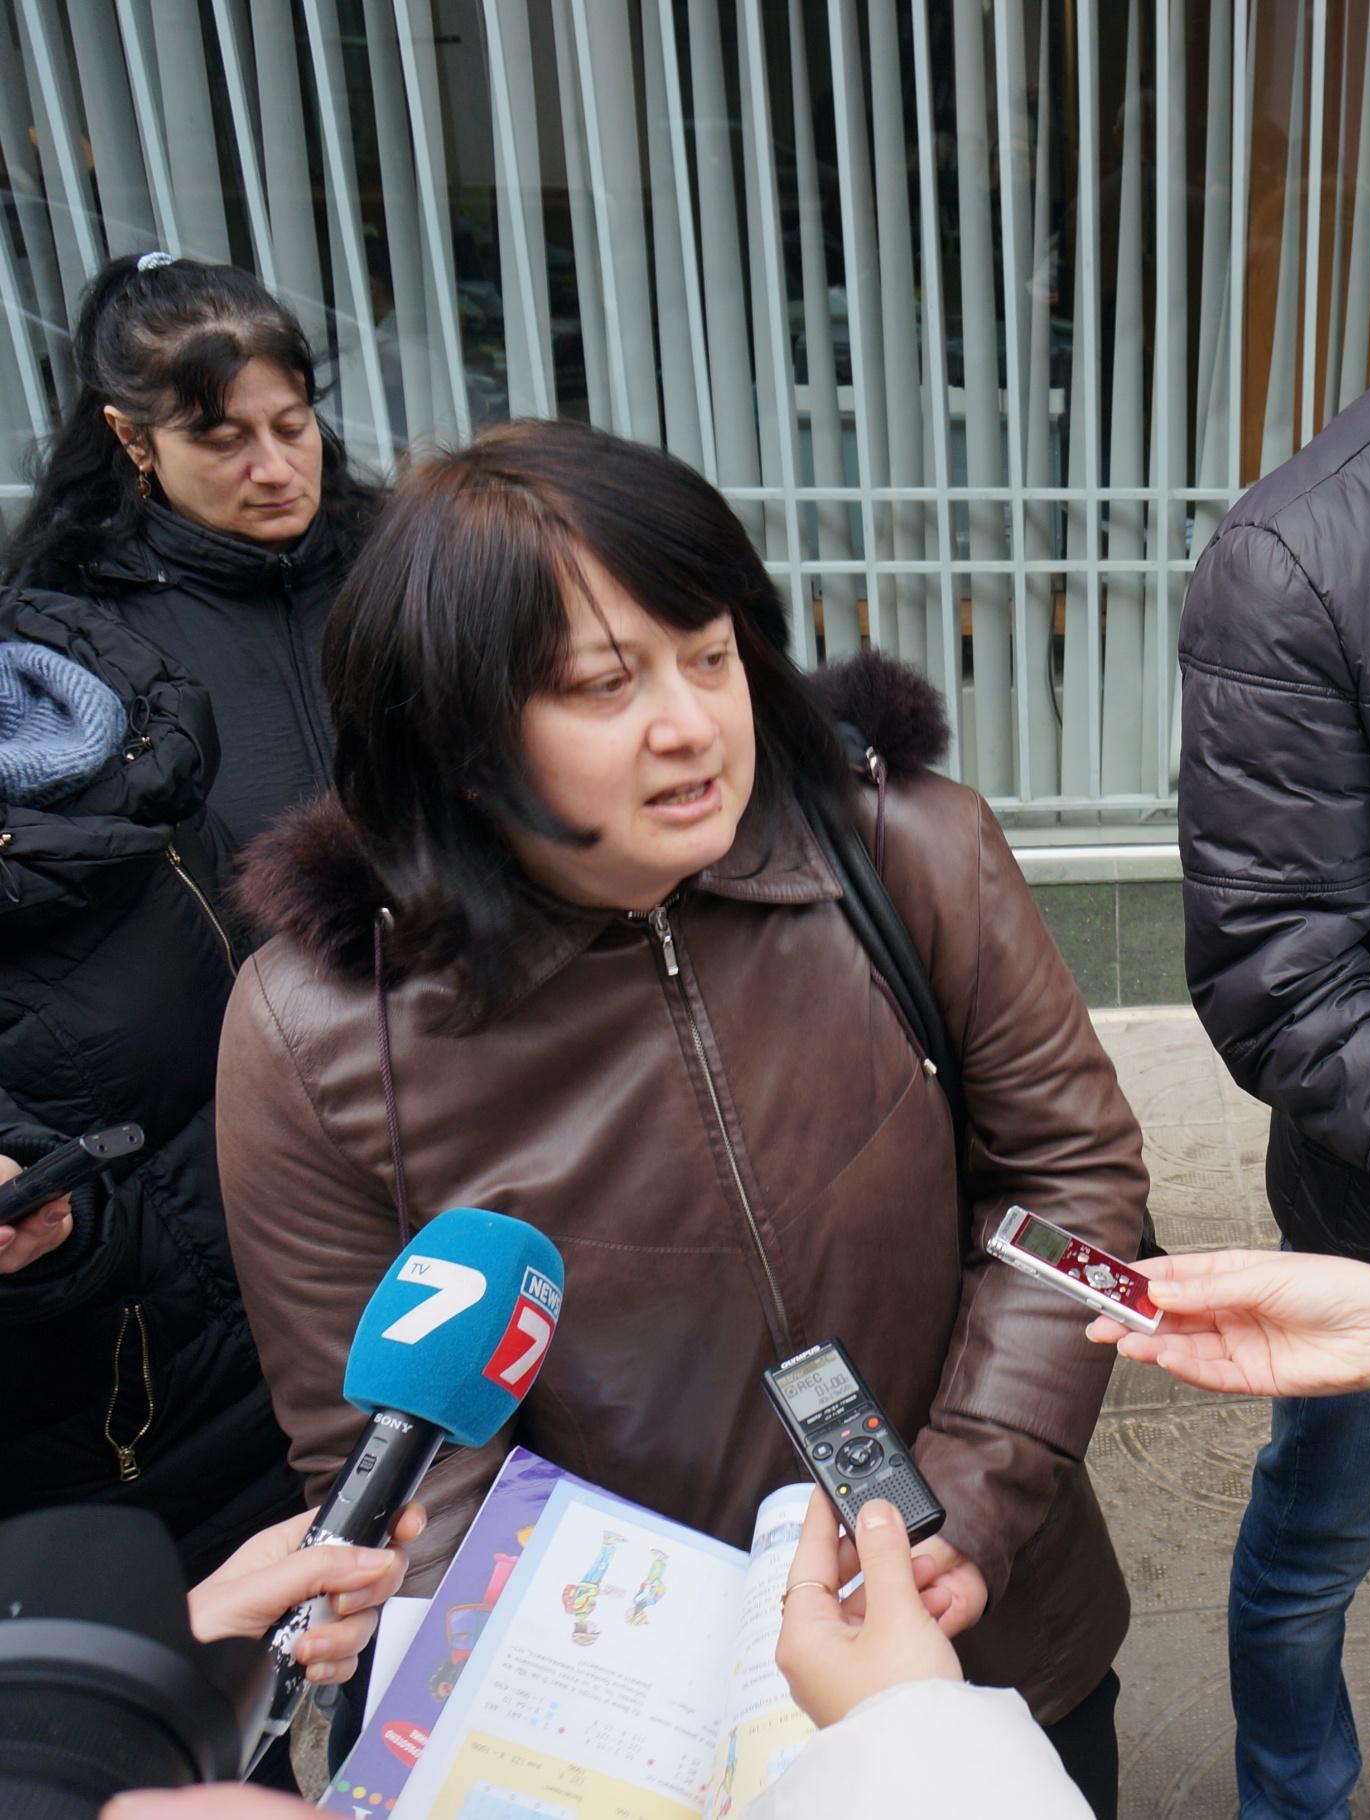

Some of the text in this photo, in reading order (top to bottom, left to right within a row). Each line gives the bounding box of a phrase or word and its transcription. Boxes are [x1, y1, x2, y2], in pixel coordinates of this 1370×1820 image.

[411, 1262, 431, 1277] TV
[380, 1254, 488, 1346] 7
[528, 1276, 562, 1317] NEWS
[499, 1305, 551, 1386] 7
[780, 1344, 822, 1370] OLYMPUS
[796, 1371, 824, 1392] REC
[372, 1411, 415, 1435] SONY
